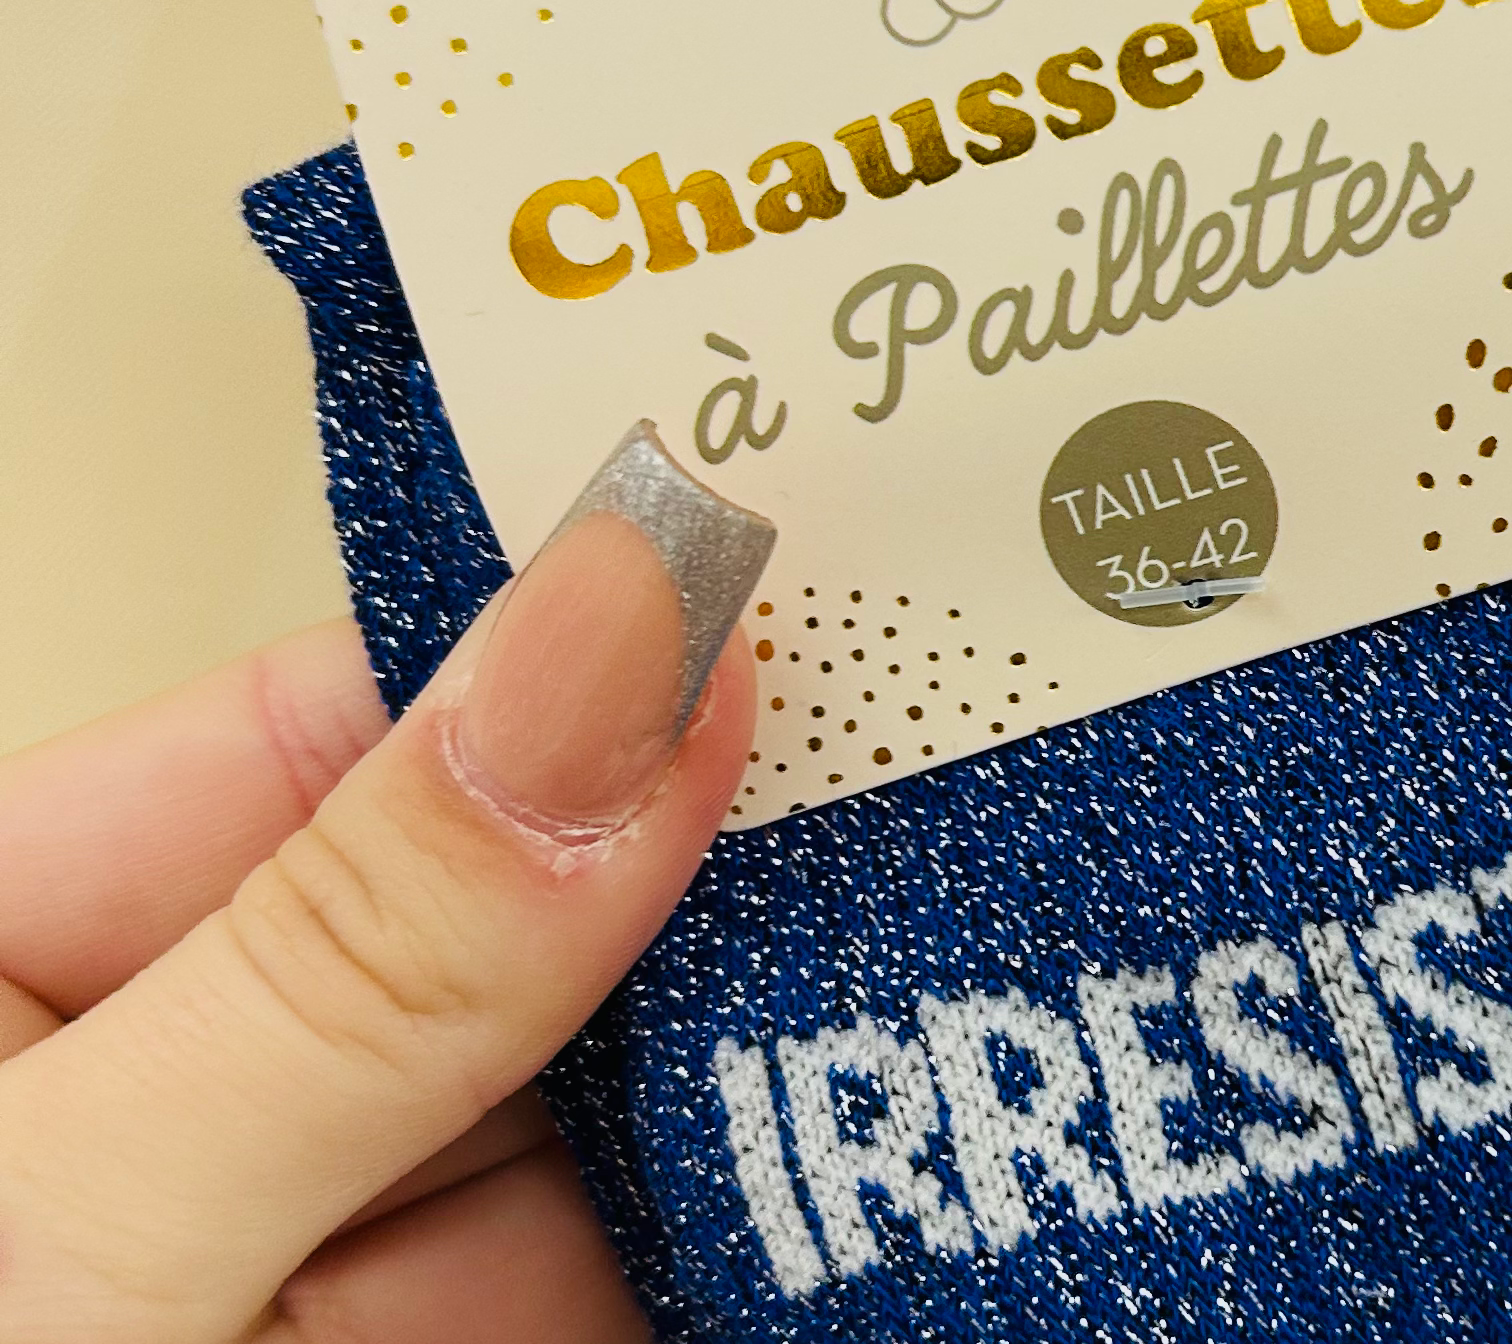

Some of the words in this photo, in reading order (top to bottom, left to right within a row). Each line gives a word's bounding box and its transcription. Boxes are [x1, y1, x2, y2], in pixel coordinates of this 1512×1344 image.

[694, 333, 787, 464] à
[832, 118, 1475, 424] Paillettes
[1050, 441, 1249, 536] TAILLE
[1095, 517, 1259, 601] 36-42
